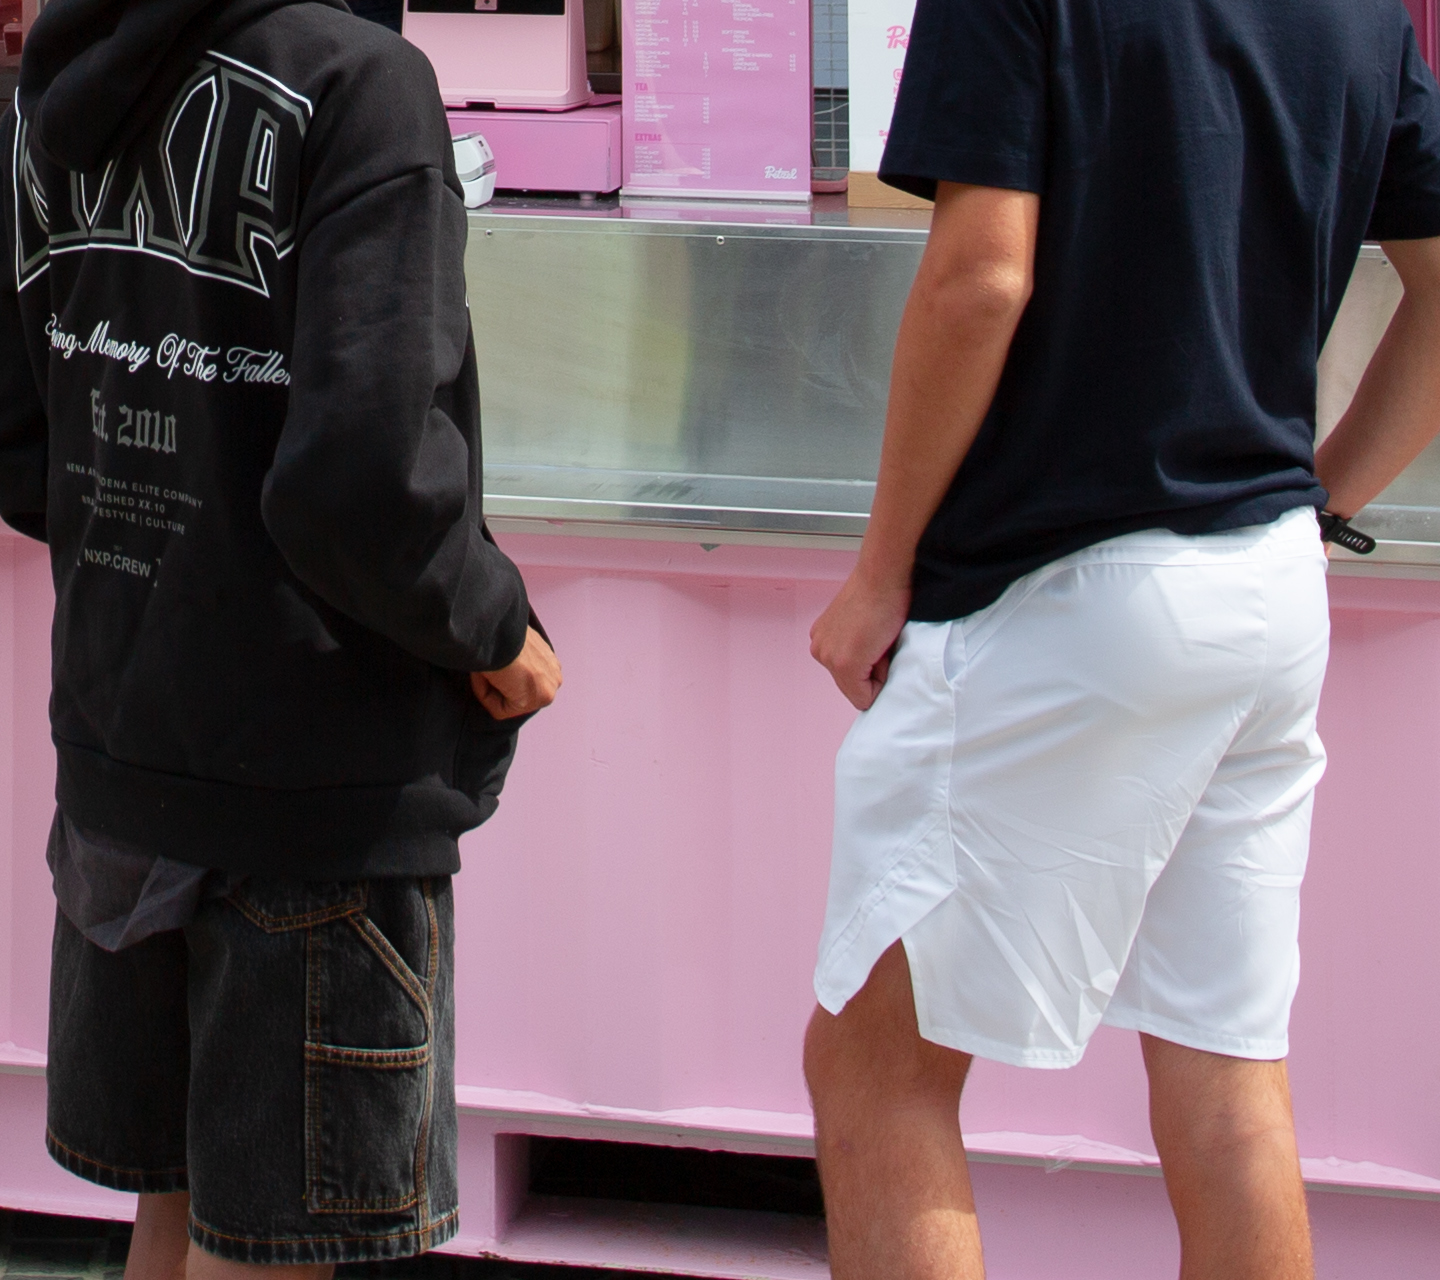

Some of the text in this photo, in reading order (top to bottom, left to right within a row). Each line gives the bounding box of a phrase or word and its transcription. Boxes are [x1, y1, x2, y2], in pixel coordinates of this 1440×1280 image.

[634, 82, 649, 92] TEA
[634, 133, 662, 142] EXTRAS
[764, 166, 798, 181] Pretzel
[78, 320, 151, 373] Memory
[156, 332, 187, 379] Of
[183, 341, 221, 382] The
[116, 403, 178, 454] 2010
[84, 547, 152, 578] NXP.CREW
